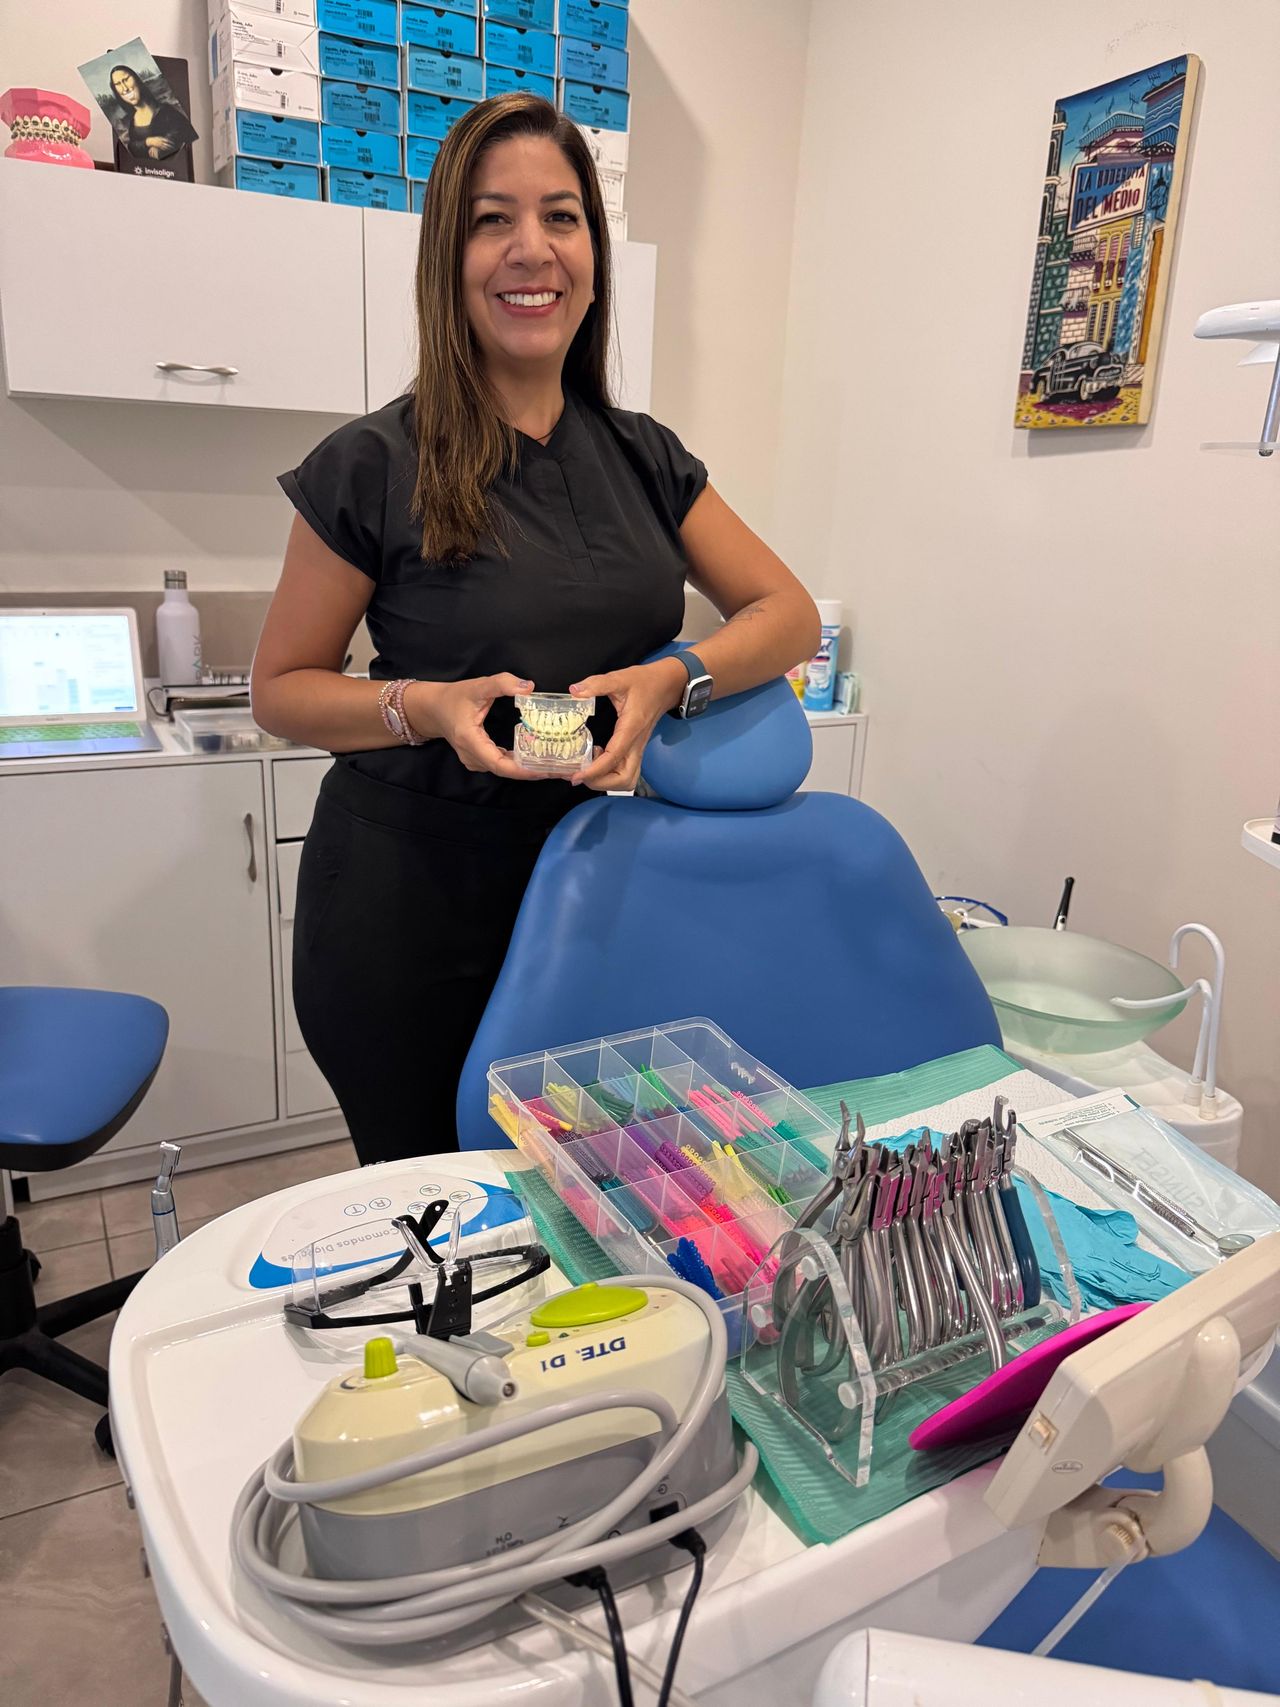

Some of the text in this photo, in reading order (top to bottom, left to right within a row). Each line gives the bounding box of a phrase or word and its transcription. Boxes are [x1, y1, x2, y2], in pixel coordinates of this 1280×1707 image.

[144, 167, 175, 178] invisalign
[1076, 188, 1140, 224] DEL MEDIO
